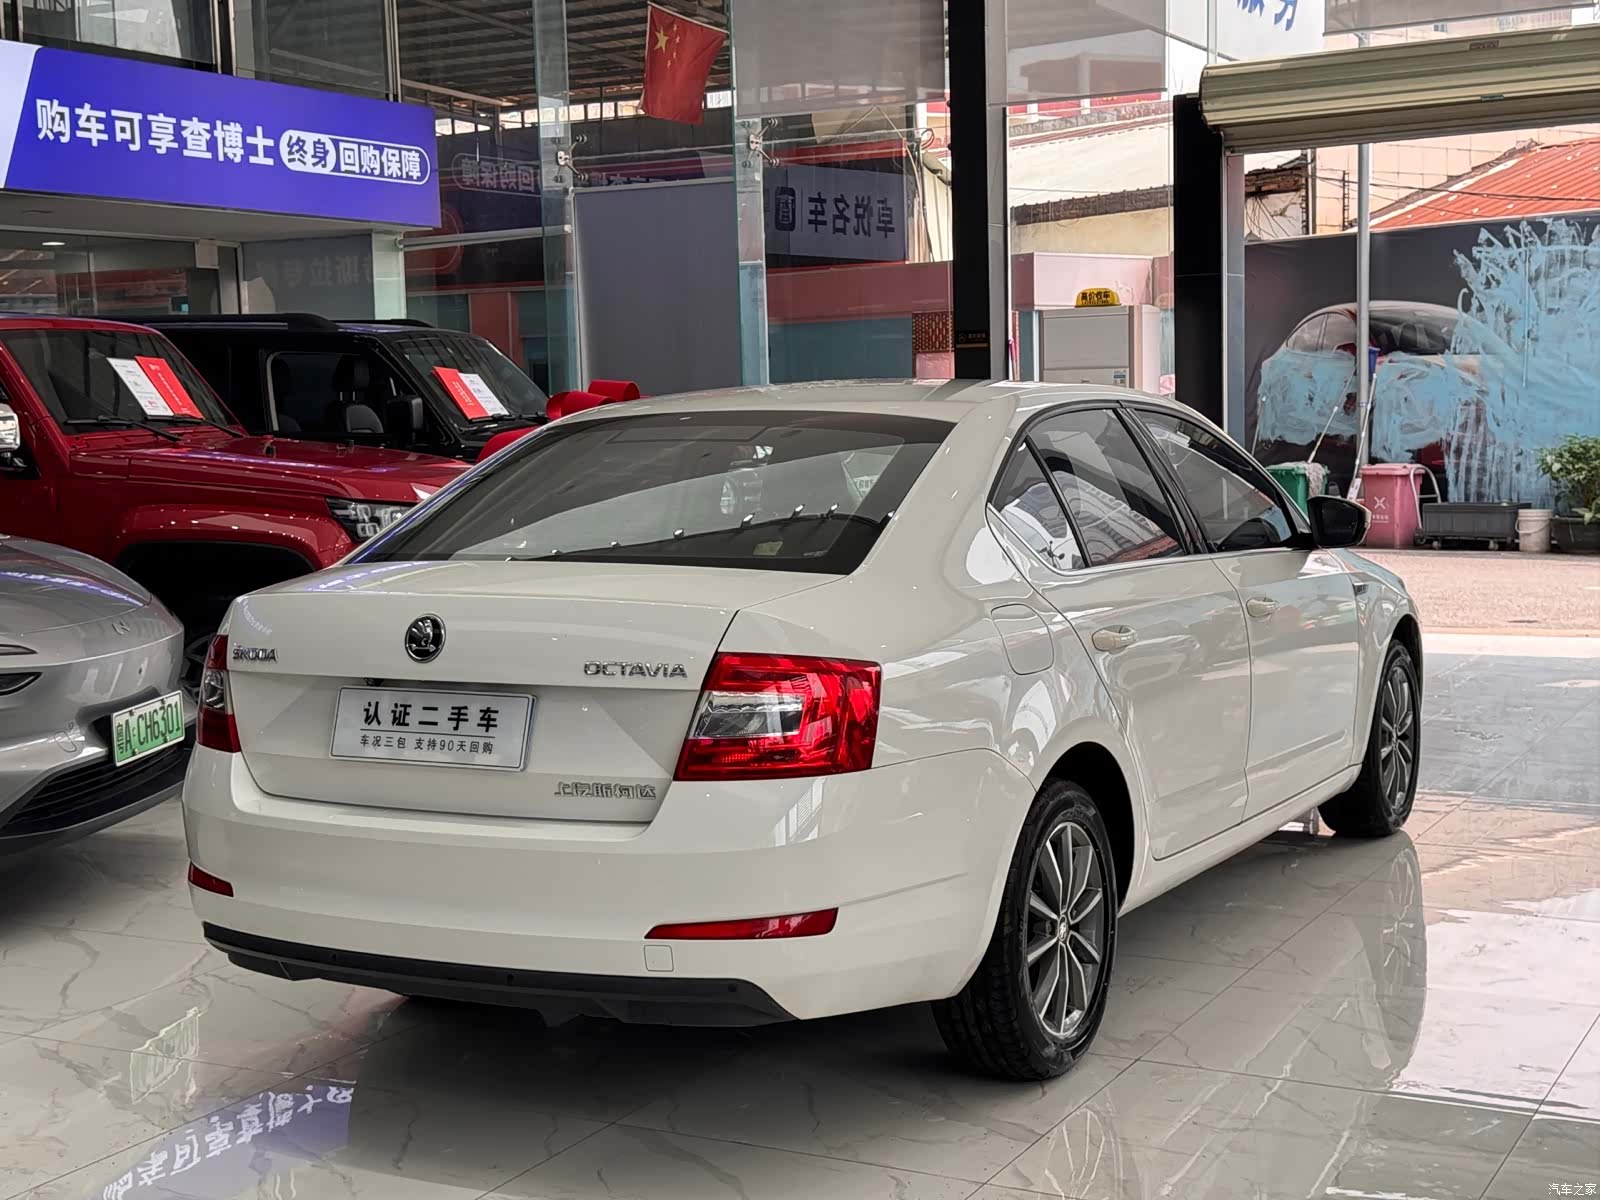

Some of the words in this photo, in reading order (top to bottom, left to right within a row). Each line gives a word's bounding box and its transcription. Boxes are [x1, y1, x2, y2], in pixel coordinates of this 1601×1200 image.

[36, 98, 275, 166] 购车可享查博士
[286, 135, 330, 169] 终身
[339, 141, 422, 181] 回购保障
[584, 661, 687, 678] OCTAVIA
[363, 701, 499, 733] 认证二手车
[360, 734, 406, 750] 车况三包
[414, 739, 494, 755] 支持90天回购
[554, 782, 657, 800] 上汽斯柯达
